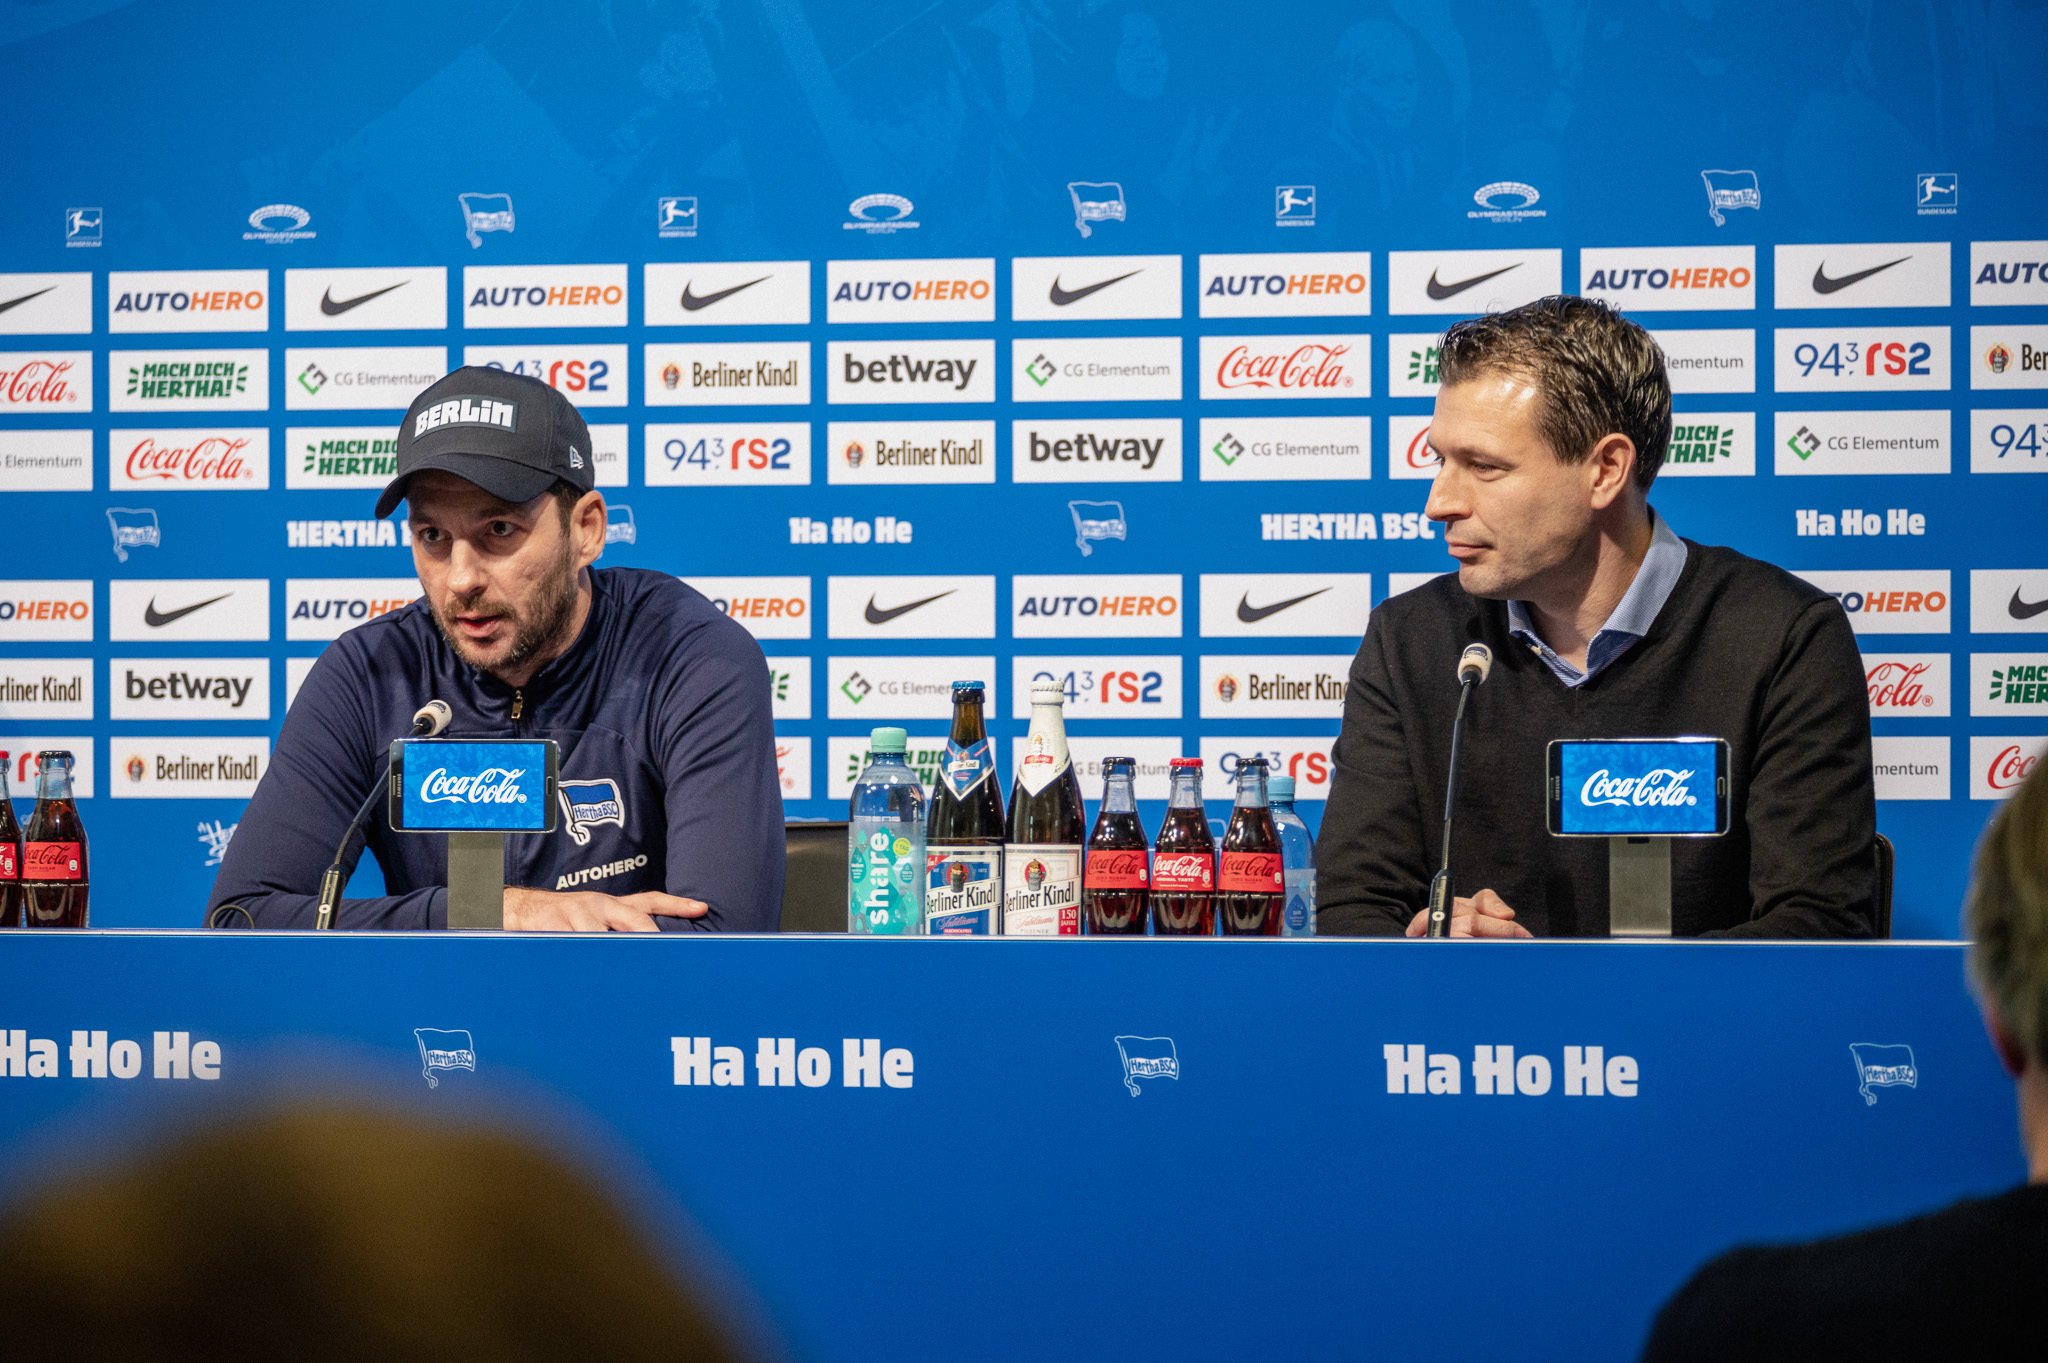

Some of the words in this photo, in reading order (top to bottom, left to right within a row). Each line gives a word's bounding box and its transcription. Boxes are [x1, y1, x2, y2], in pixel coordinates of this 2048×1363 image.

[1206, 274, 1365, 296] AUTOHERO
[1586, 268, 1750, 290] AUTOHERO
[114, 292, 263, 312] AUTOHERO
[470, 286, 622, 307] AUTOHERO
[834, 281, 989, 301] AUTOHERO
[1064, 363, 1083, 377] CG
[1088, 363, 1170, 376] Elementum
[1217, 345, 1352, 389] Coca-Cola
[1667, 355, 1743, 370] lementum
[1866, 342, 1931, 376] rs2
[142, 364, 190, 381] MACH
[195, 363, 235, 380] DICH
[334, 372, 353, 386] CG
[357, 371, 437, 386] Elementum
[692, 362, 753, 387] Berliner
[756, 361, 798, 386] Kindl
[845, 353, 977, 390] betway
[141, 382, 231, 398] HERTHA!
[1674, 425, 1719, 442] DICH
[1828, 437, 1848, 450] CG
[1853, 437, 1939, 449] Elementum
[320, 441, 366, 454] MACH
[371, 440, 397, 454] DIC
[732, 438, 791, 470] rs2
[876, 441, 936, 466] Berliner
[941, 439, 983, 465] Kindl
[1030, 432, 1164, 470] betway
[1251, 443, 1271, 456] CG
[1276, 442, 1359, 456] Elementum
[5, 455, 82, 468] Elementum
[126, 438, 251, 479] Coca-Cola
[287, 520, 397, 547] HERTHA
[789, 517, 827, 543] Ha
[832, 517, 870, 543] Ho
[874, 517, 912, 543] He
[1261, 514, 1377, 540] HERTHA
[1383, 513, 1437, 540] BSC
[1796, 510, 1835, 536] Ha
[1841, 510, 1881, 536] Ho
[1887, 509, 1925, 535] He
[0, 601, 88, 620] OHERO
[1019, 596, 1176, 616] AUTOHERO
[2006, 666, 2048, 681] MAC
[43, 676, 81, 701] Kindl
[126, 671, 252, 707] betway
[879, 683, 898, 694] CG
[1101, 671, 1162, 703] rs2
[1249, 675, 1309, 699] Berliner
[1315, 674, 1347, 699] Kin
[156, 756, 214, 780] Berliner
[218, 755, 258, 780] Kindl
[1874, 764, 1938, 775] mentum
[421, 768, 526, 803] Coca-Cola
[1581, 769, 1697, 806] Coca-Cola
[575, 804, 602, 819] Hertha
[602, 802, 618, 816] BSC
[556, 854, 648, 890] AUTOHERO
[1088, 853, 1140, 875] Coca-Cola
[1153, 855, 1204, 877] Coca-Cola
[1222, 856, 1275, 878] Coca-Cola
[864, 833, 889, 925] share
[927, 891, 963, 914] Berliner
[966, 882, 996, 907] Kindl
[1006, 890, 1041, 913] Berliner
[1043, 881, 1074, 906] Kindl
[1061, 909, 1077, 919] 150
[0, 1029, 58, 1077] Ha
[70, 1030, 142, 1079] Ho
[153, 1031, 221, 1080] He
[430, 1050, 457, 1066] Hertha
[456, 1051, 473, 1066] BSC
[671, 1037, 744, 1085] Ha
[756, 1037, 831, 1087] Ho
[843, 1038, 914, 1088] He
[1131, 1058, 1158, 1073] Hertha
[1158, 1057, 1175, 1073] BSC
[1384, 1044, 1461, 1094] Ha
[1473, 1045, 1552, 1096] Ho
[1564, 1046, 1638, 1097] He
[1866, 1066, 1896, 1083] Hertha
[1896, 1066, 1914, 1081] BSC
